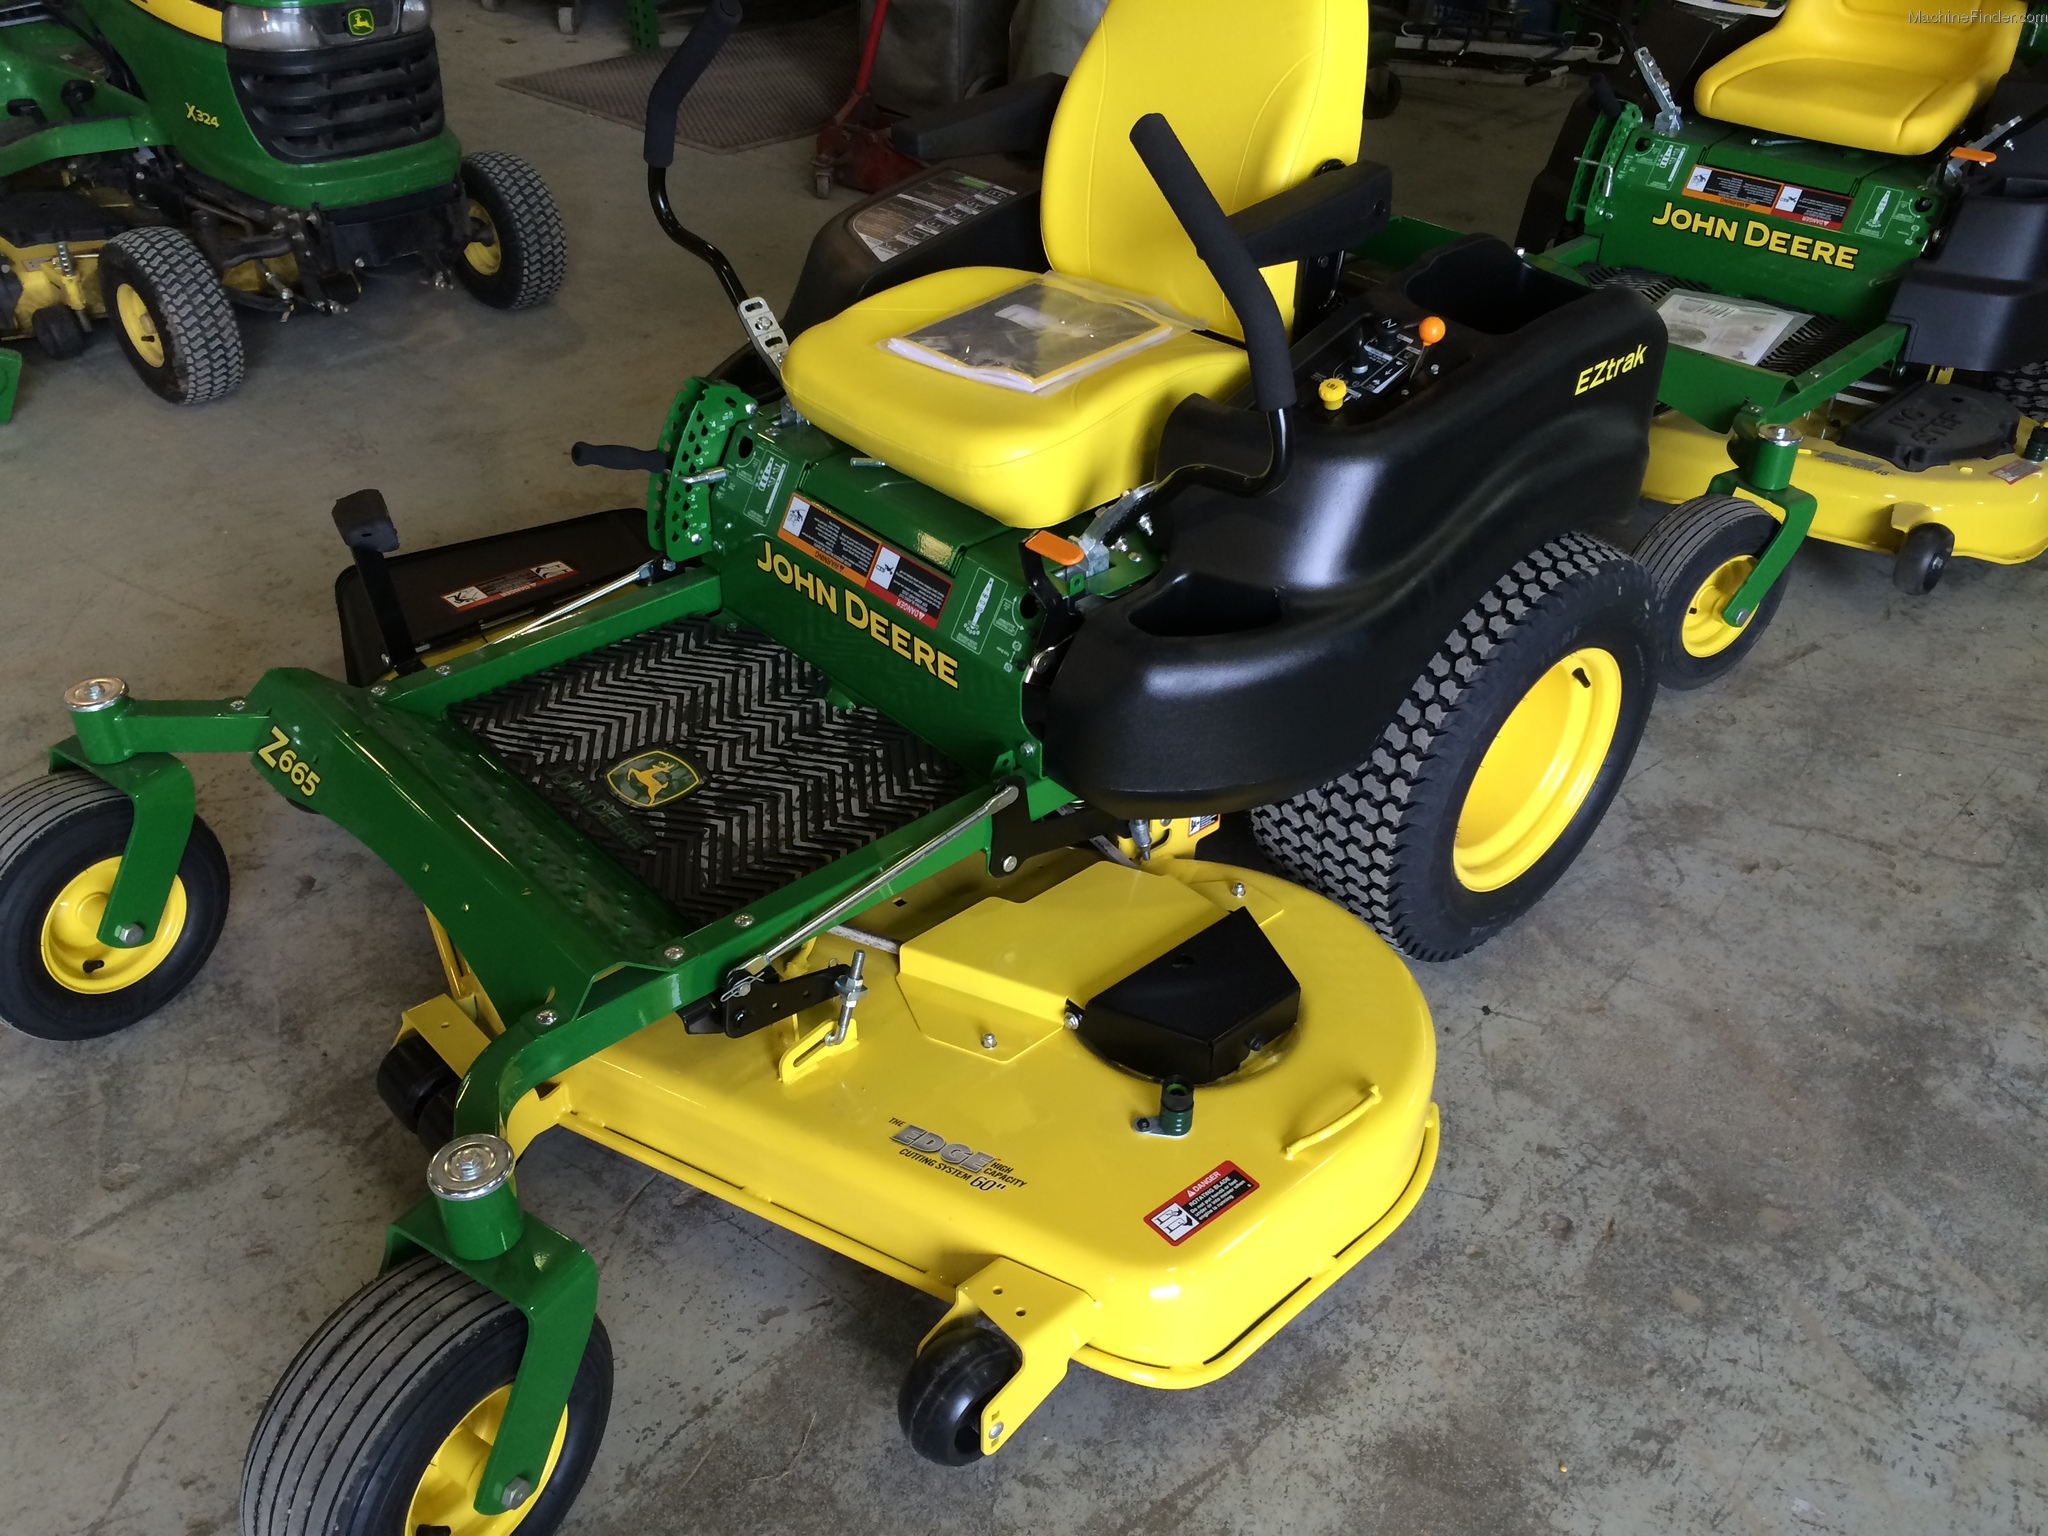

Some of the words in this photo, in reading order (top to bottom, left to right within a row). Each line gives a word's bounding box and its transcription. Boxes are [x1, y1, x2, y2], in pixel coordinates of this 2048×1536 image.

[185, 102, 220, 128] X324
[1652, 201, 1739, 242] JOHN
[1743, 219, 1859, 270] DEERE
[1574, 343, 1648, 396] EZtrak
[814, 550, 839, 569] WARNING
[757, 541, 837, 614] JOHN
[844, 588, 959, 689] DEERE
[895, 598, 919, 617] DANGER
[258, 725, 321, 796] Z665
[586, 800, 650, 850] DEERE
[888, 1117, 906, 1127] THE
[889, 1124, 996, 1174] EDGE
[899, 1148, 938, 1167] CUTTING
[935, 1162, 973, 1181] SYSTEM
[969, 1176, 1007, 1192] 60"
[983, 1167, 1028, 1188] CAPACITY
[990, 1162, 1014, 1174] HIGH
[1191, 1170, 1221, 1192] DANGER
[1188, 1187, 1214, 1206] ROTATING
[1212, 1175, 1231, 1189] BLADE
